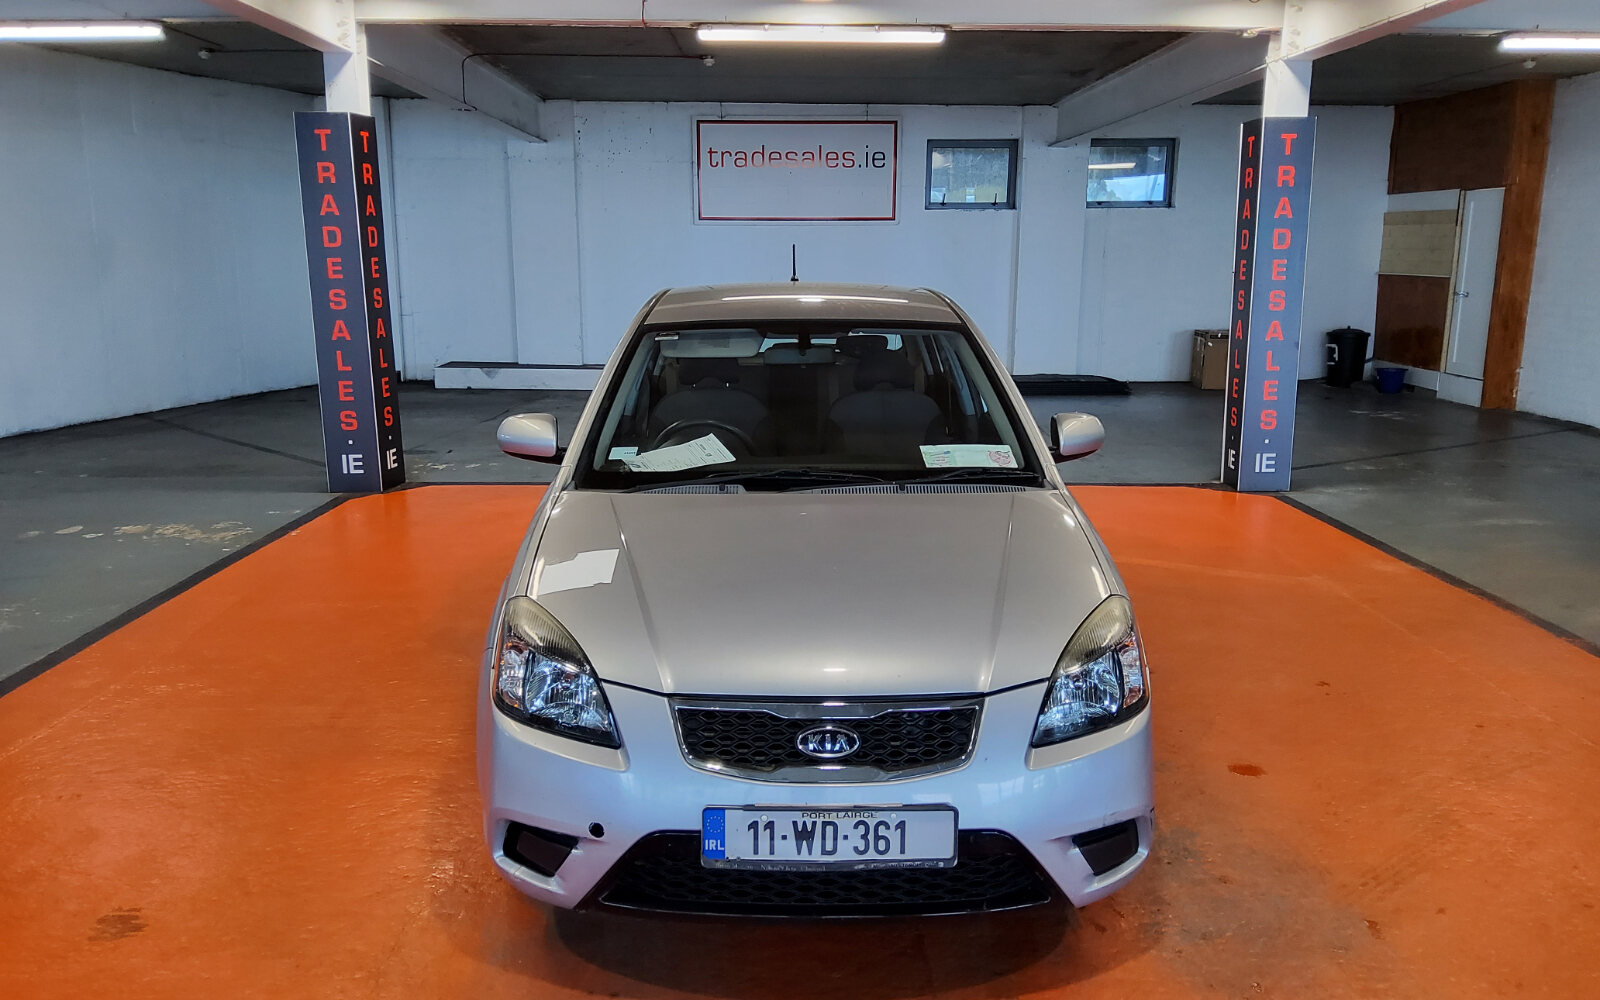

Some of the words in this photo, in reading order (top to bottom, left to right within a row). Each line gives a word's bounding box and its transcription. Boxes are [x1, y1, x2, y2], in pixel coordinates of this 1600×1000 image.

[707, 145, 886, 168] tradesales.ie
[807, 733, 850, 751] KIA
[802, 811, 833, 819] PORT
[705, 839, 725, 850] IRL
[747, 820, 906, 855] 11-WD-361
